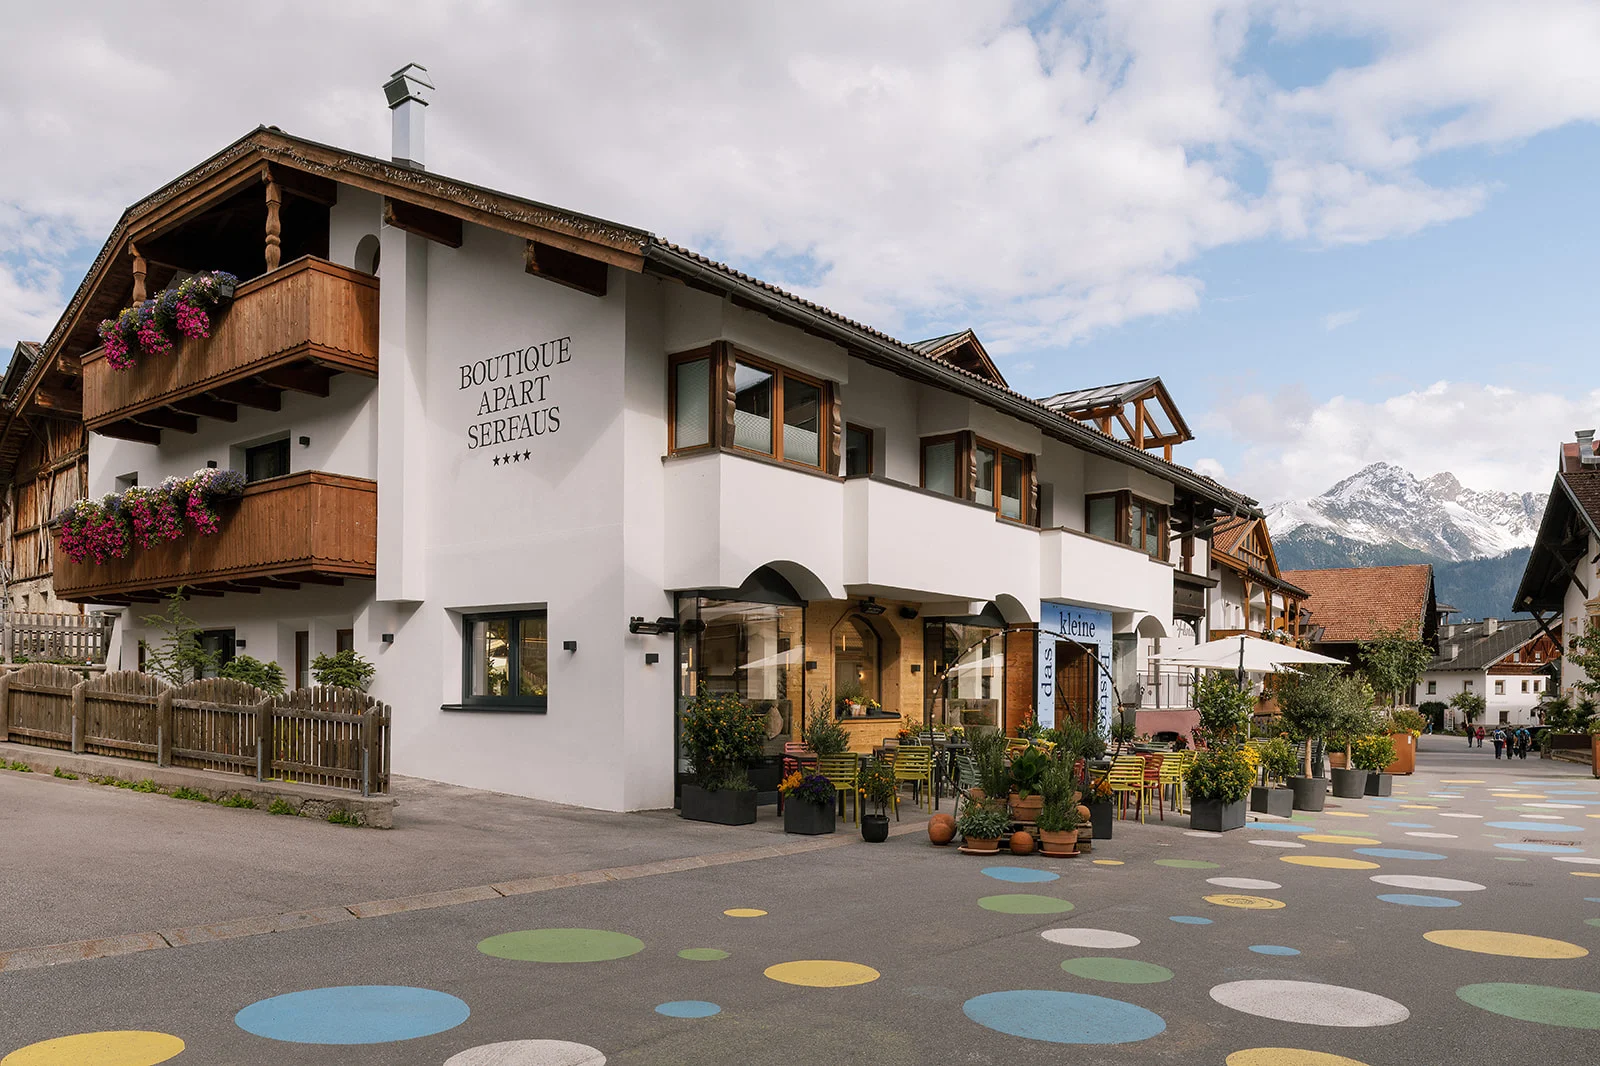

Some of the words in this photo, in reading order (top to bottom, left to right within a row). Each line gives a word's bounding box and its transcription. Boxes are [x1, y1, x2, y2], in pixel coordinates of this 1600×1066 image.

[459, 336, 572, 391] BOUTIQUE
[477, 374, 551, 416] APART
[467, 406, 561, 450] SERFAUS
[1059, 611, 1096, 638] kleine
[1041, 647, 1053, 697] das
